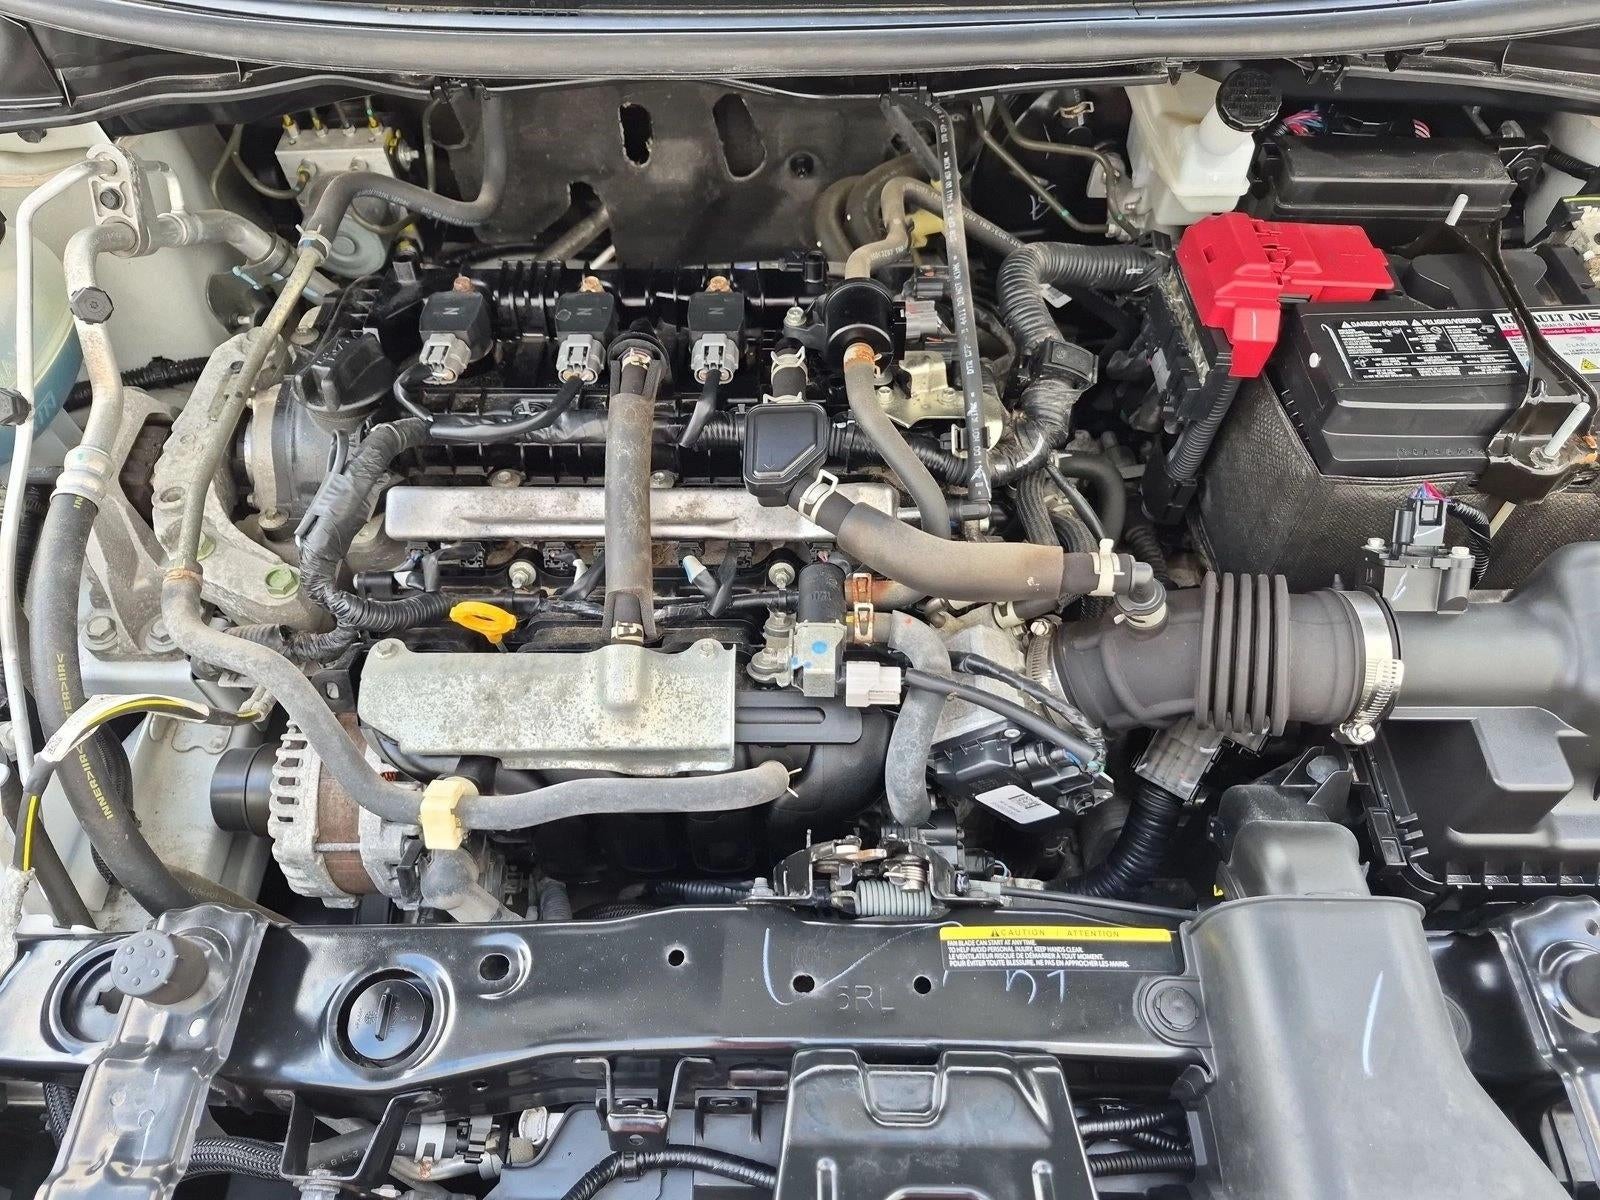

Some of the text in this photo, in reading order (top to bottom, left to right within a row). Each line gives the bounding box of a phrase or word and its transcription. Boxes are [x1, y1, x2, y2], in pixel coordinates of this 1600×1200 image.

[1568, 312, 1600, 320] NIS
[1351, 319, 1409, 328] DANGER/POISON
[1421, 317, 1482, 325] PELIGRO/VENENO
[967, 959, 986, 967] ÉVITER
[1064, 960, 1098, 968] APPROCHER
